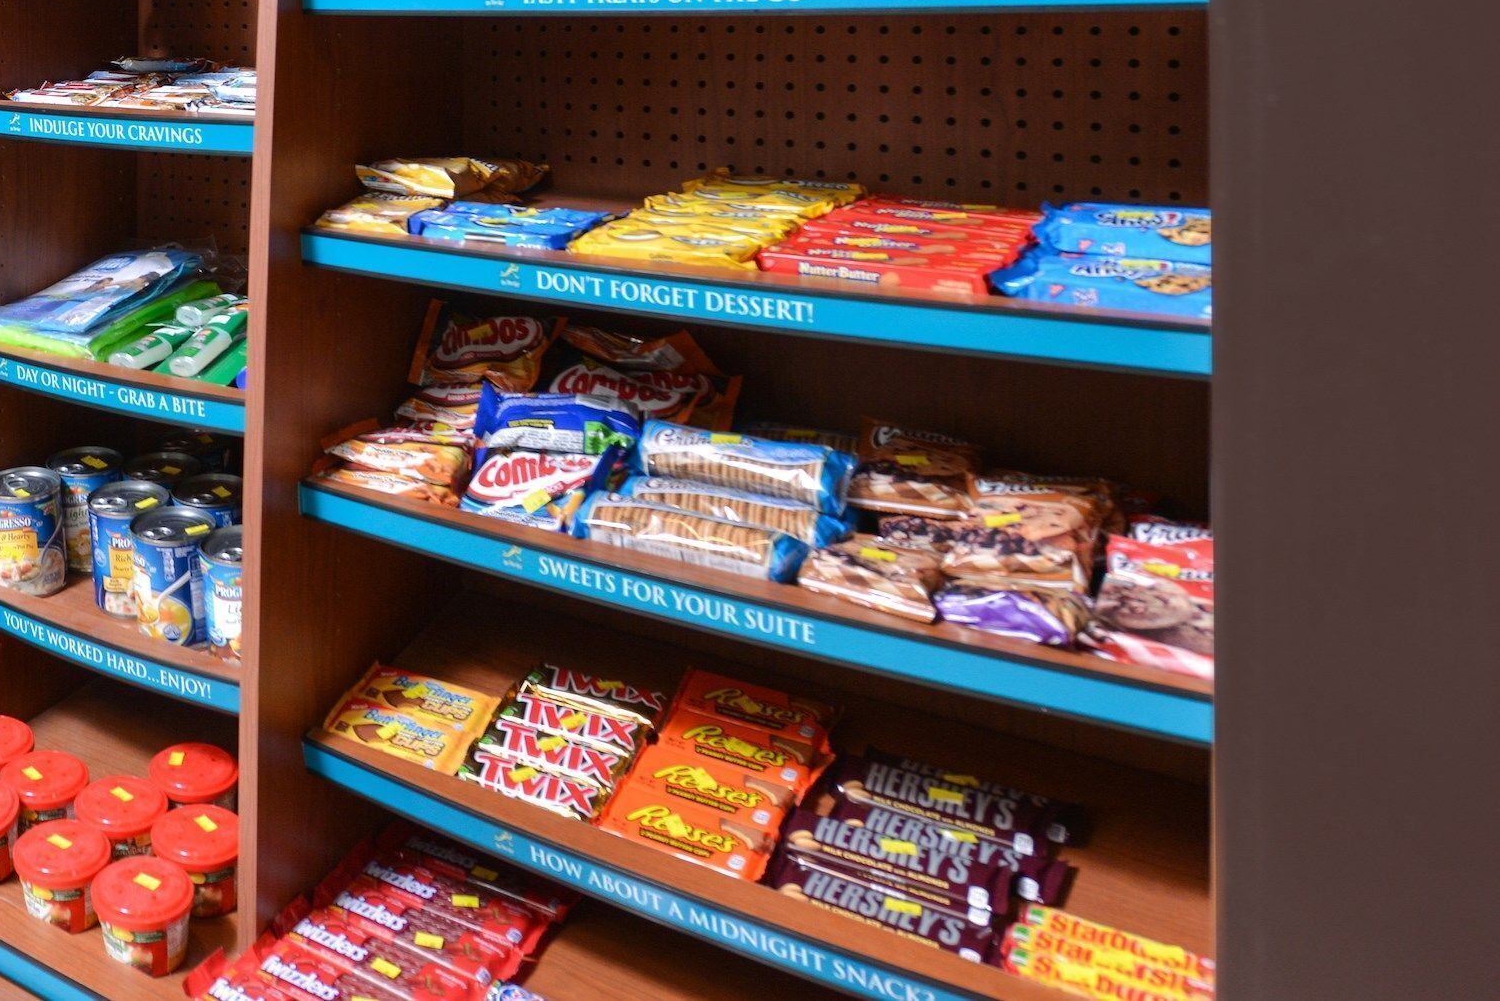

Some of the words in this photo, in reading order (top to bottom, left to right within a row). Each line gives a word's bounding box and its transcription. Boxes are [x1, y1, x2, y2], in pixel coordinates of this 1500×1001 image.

[29, 117, 85, 137] INDULGE
[86, 121, 126, 140] YOUR
[128, 124, 203, 144] CRAVINGS
[537, 271, 604, 297] DON'T
[611, 280, 699, 309] FORGET
[705, 290, 814, 323] DESSERT!
[16, 364, 39, 383] DAY
[41, 371, 60, 390] OR
[62, 376, 106, 399] NIGHT
[117, 388, 155, 409] GRAB
[159, 395, 169, 411] A
[172, 397, 206, 418] BITE
[539, 556, 616, 594] SWEETS
[622, 577, 667, 609] FOR
[671, 590, 737, 626] YOUR
[744, 609, 816, 645] SUITE
[3, 611, 46, 639] YOU'VE
[47, 629, 103, 664] WORKED
[845, 850, 894, 873] CHOCOLATE
[907, 870, 950, 890] ALMONDS
[530, 846, 583, 881] HOW
[588, 870, 662, 913] ABOUT
[669, 900, 685, 920] A
[688, 906, 827, 973] MIDNIGHT
[833, 960, 936, 1001] SNACK?
